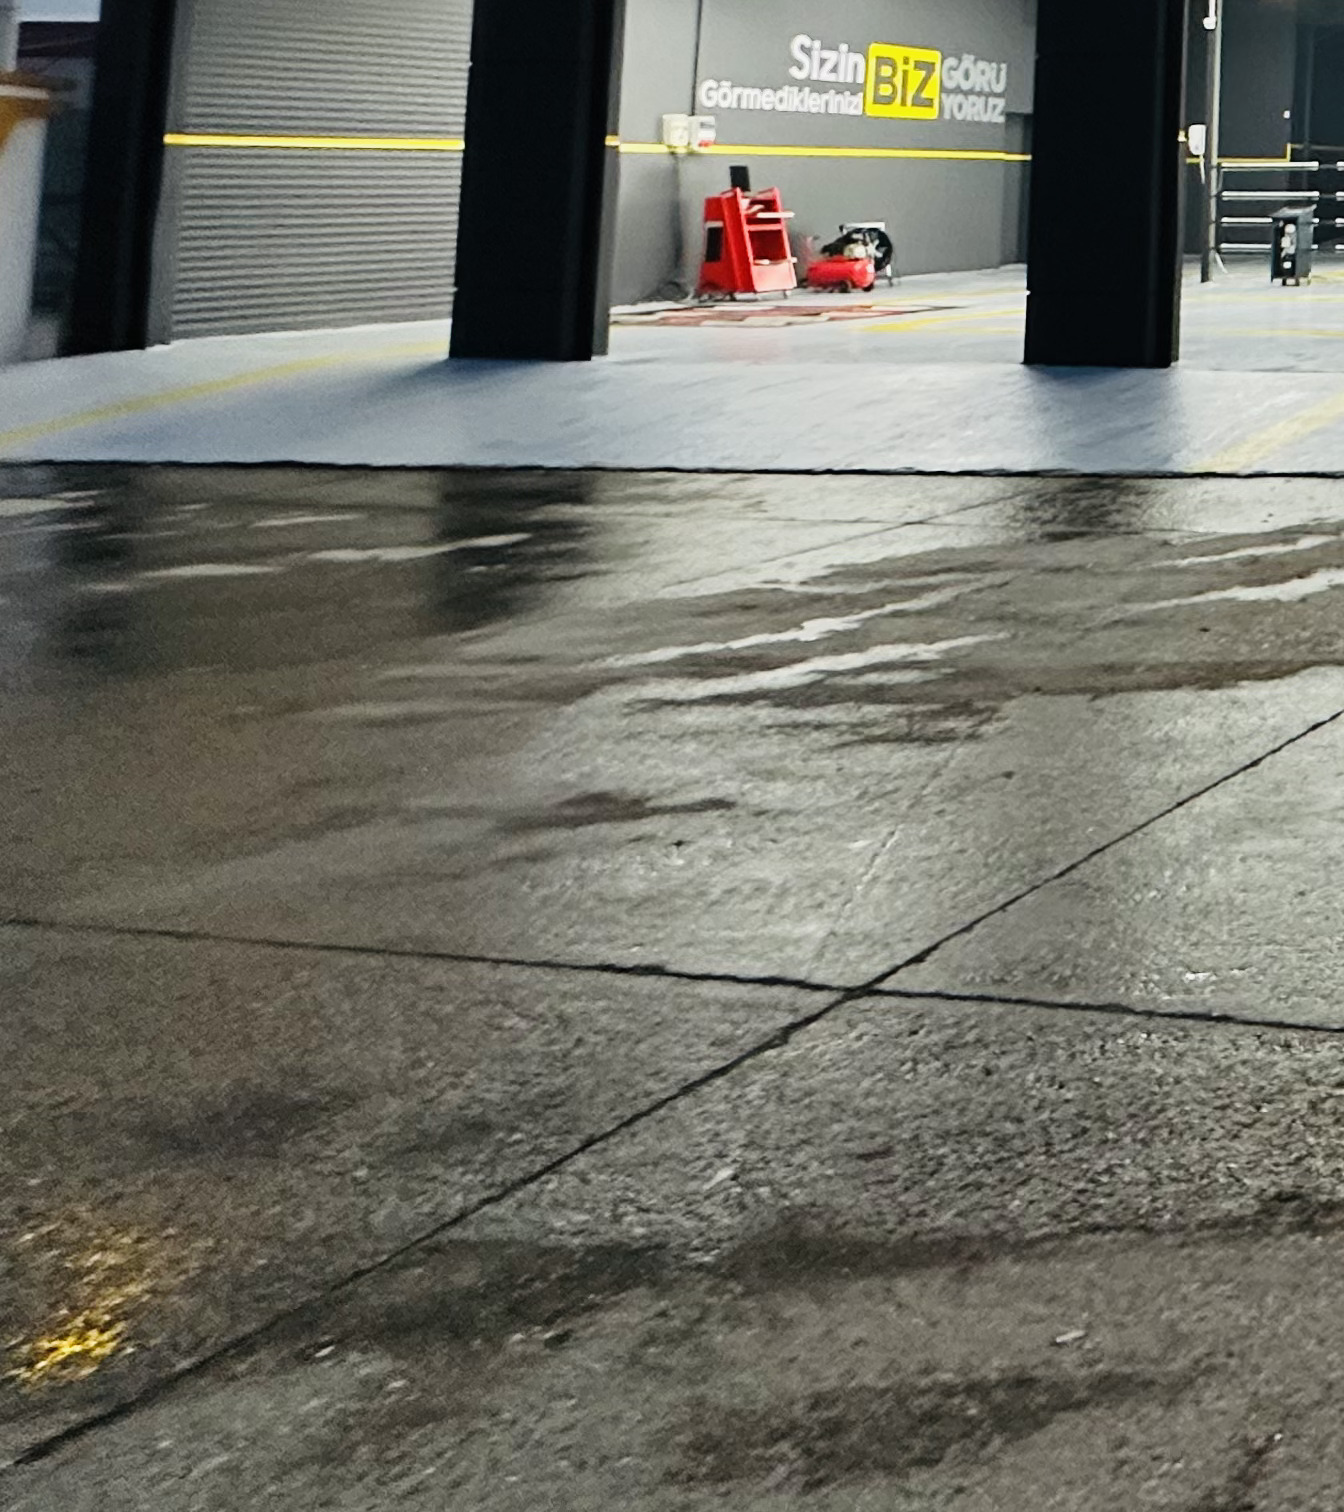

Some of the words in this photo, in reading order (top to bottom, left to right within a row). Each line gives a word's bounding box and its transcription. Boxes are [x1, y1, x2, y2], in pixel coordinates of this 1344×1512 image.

[789, 34, 866, 84] Sizin
[700, 79, 864, 116] Görmediklerinizi
[941, 92, 1006, 123] YORUZ
